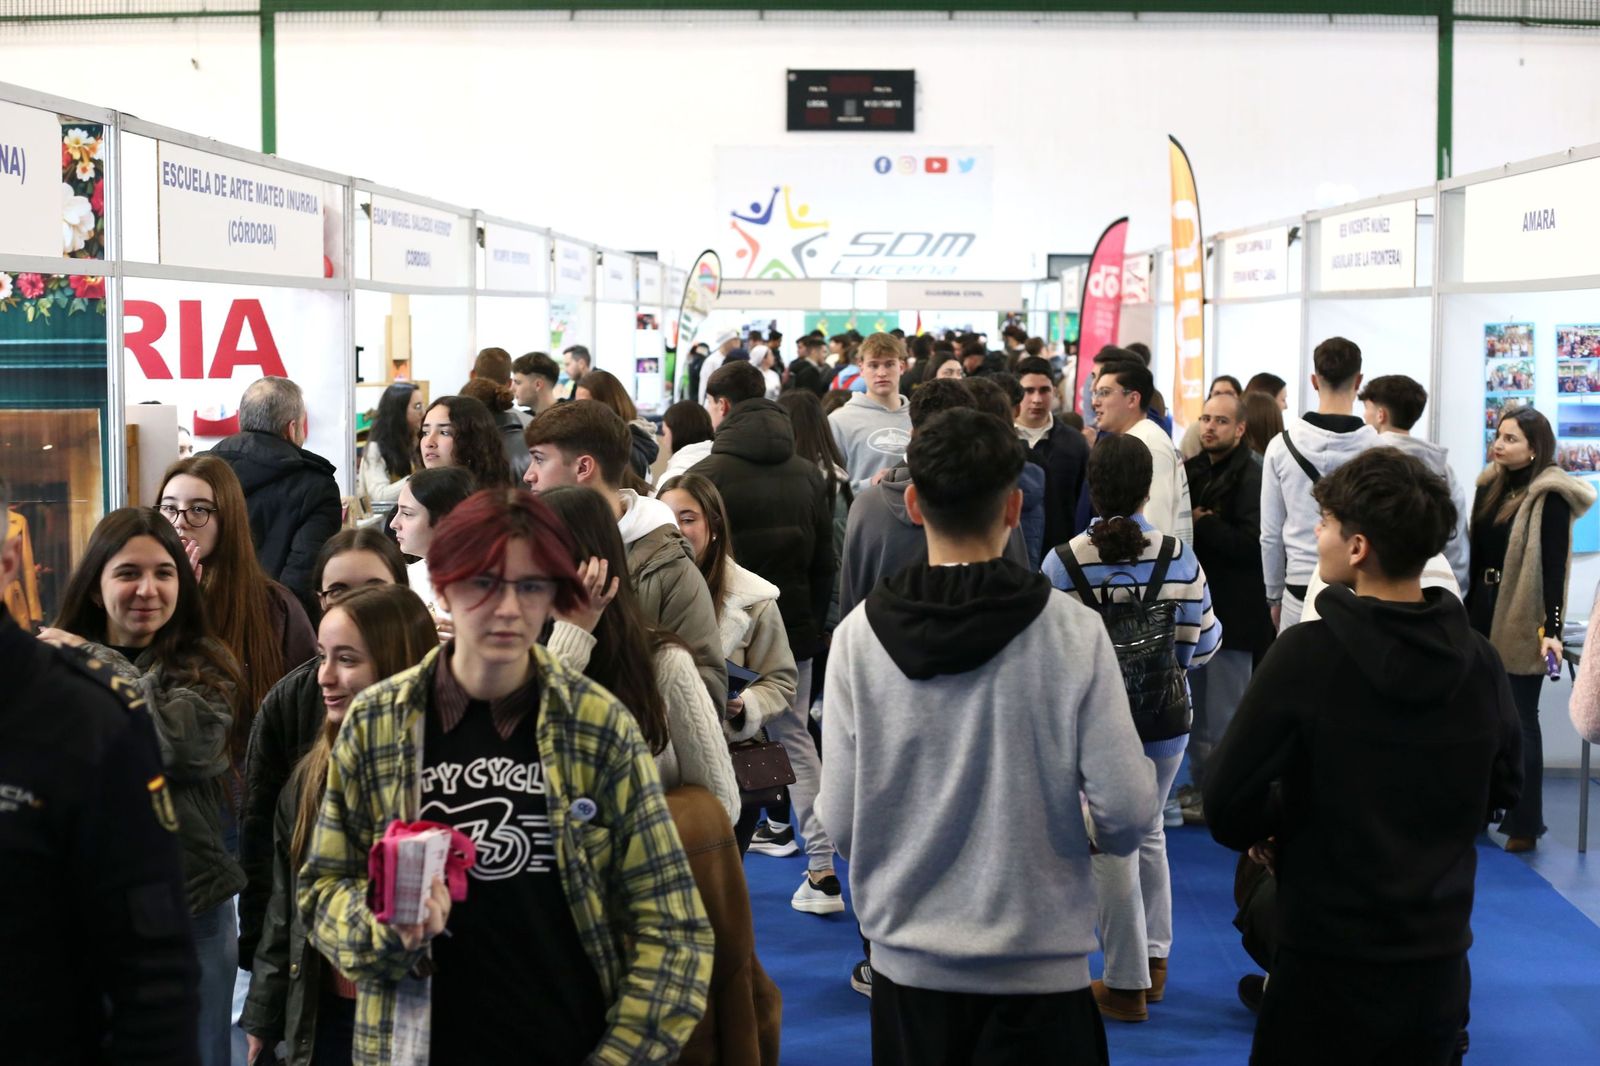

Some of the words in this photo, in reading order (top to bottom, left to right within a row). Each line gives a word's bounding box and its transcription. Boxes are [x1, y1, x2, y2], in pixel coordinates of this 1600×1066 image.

[0, 144, 26, 184] NA)
[163, 161, 211, 194] ESCUELA
[214, 173, 226, 197] DE
[229, 177, 253, 202] ARTE
[256, 182, 284, 208] MATEO
[287, 189, 318, 215] INURRIA
[228, 216, 276, 249] (CÓRDOBA)
[1523, 208, 1555, 232] AMARA
[842, 232, 977, 257] SDM
[124, 299, 288, 379] RIA
